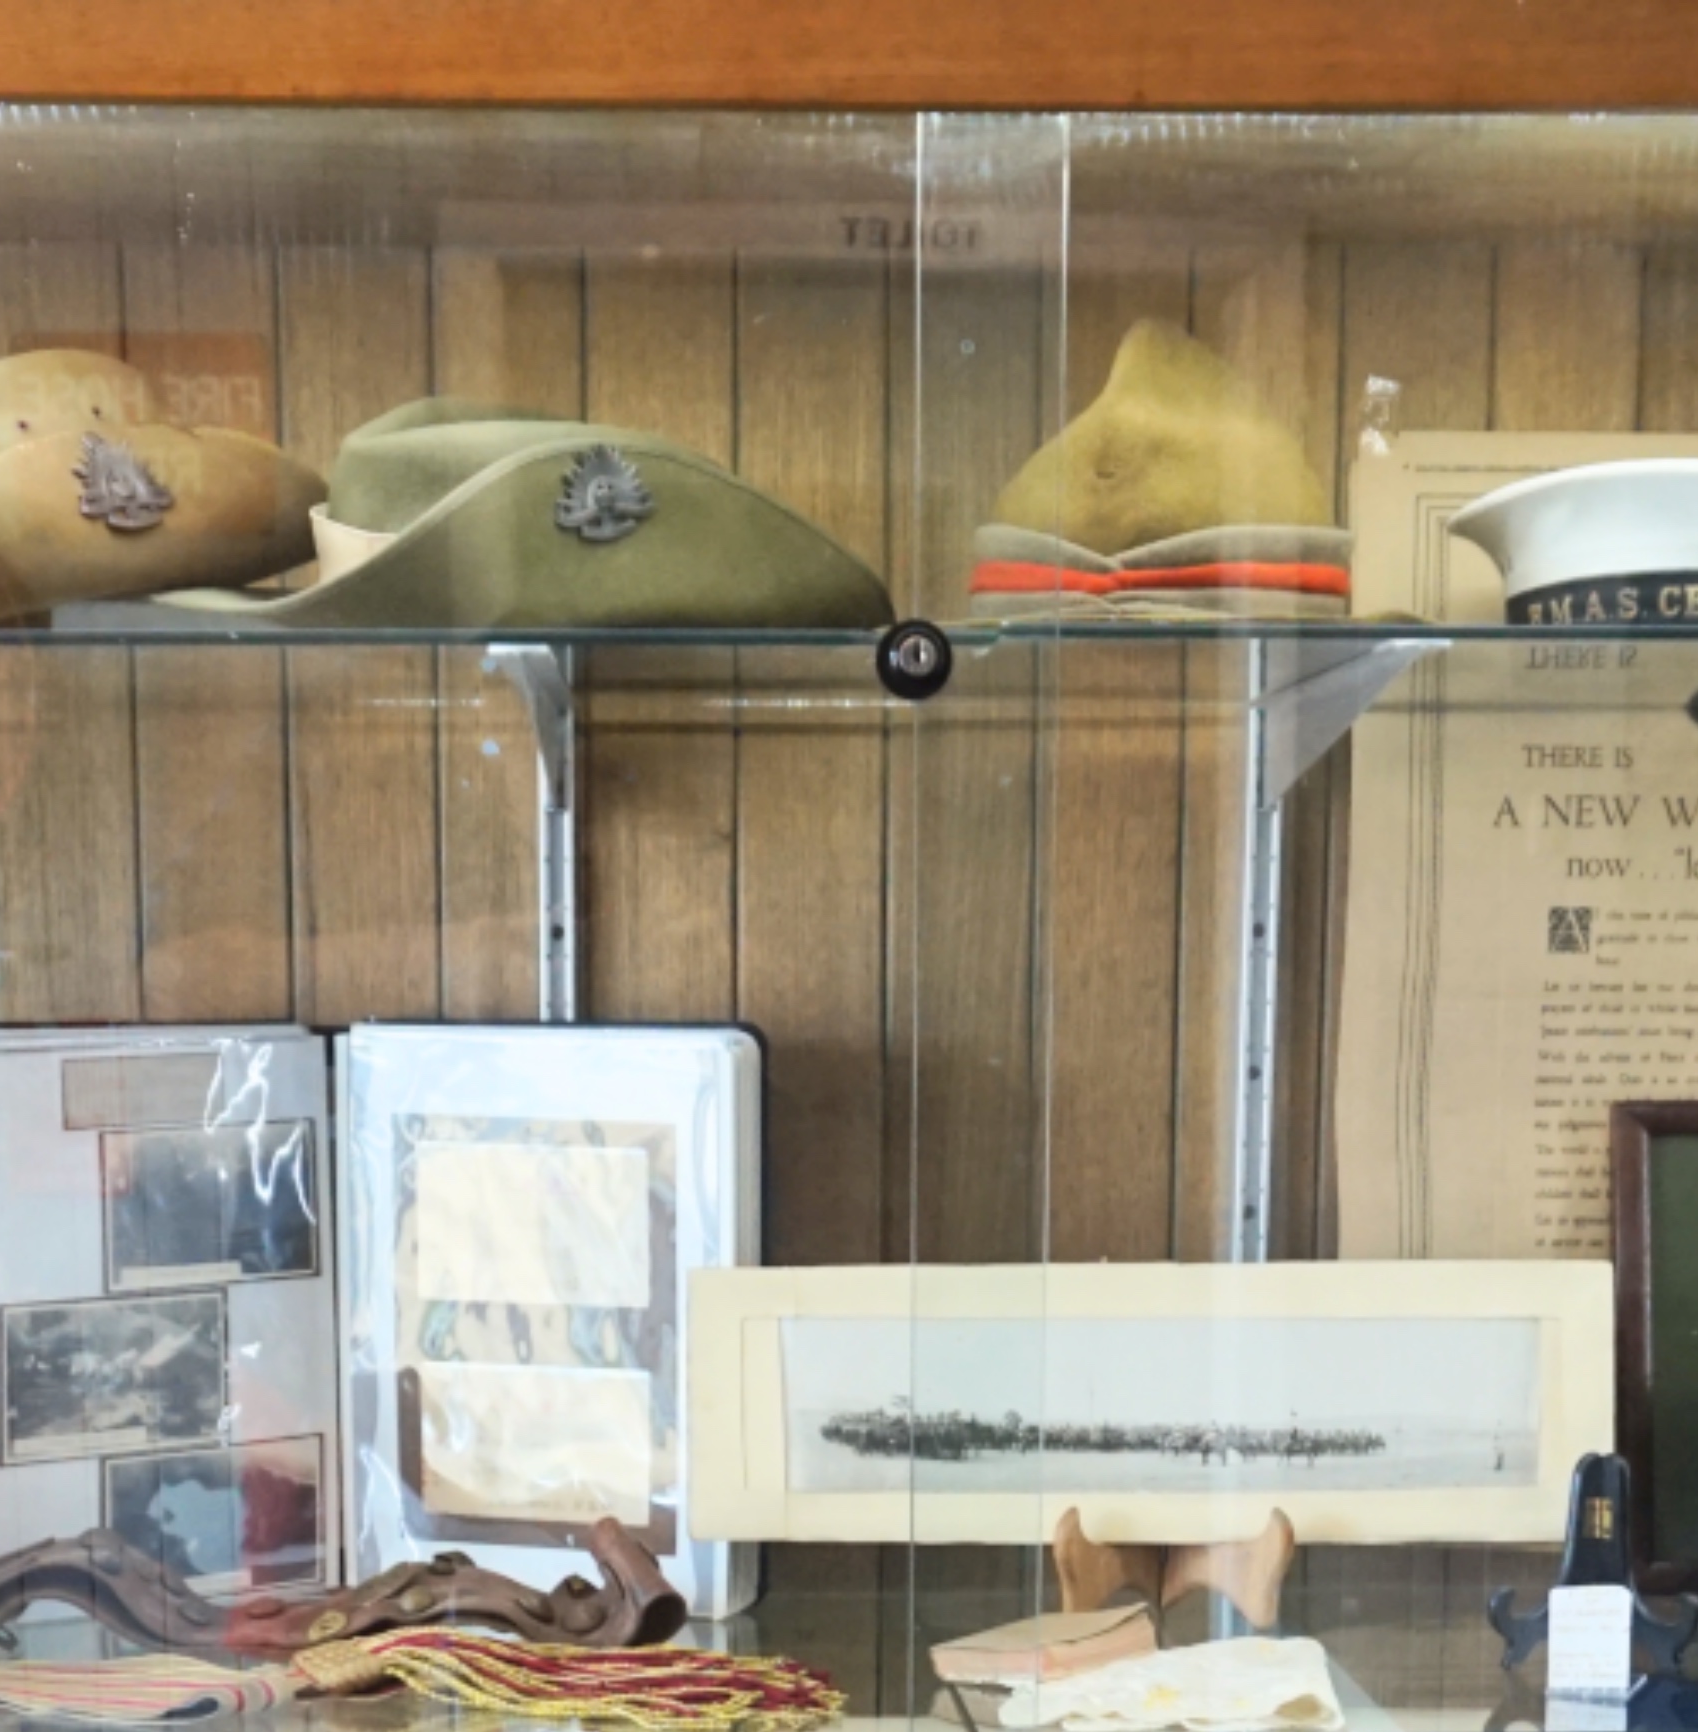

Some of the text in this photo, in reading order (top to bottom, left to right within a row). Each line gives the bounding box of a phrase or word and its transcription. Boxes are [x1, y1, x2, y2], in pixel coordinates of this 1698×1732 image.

[1522, 745, 1635, 768] THERE IS
[1493, 797, 1521, 829] A
[1542, 795, 1641, 829] NEW
